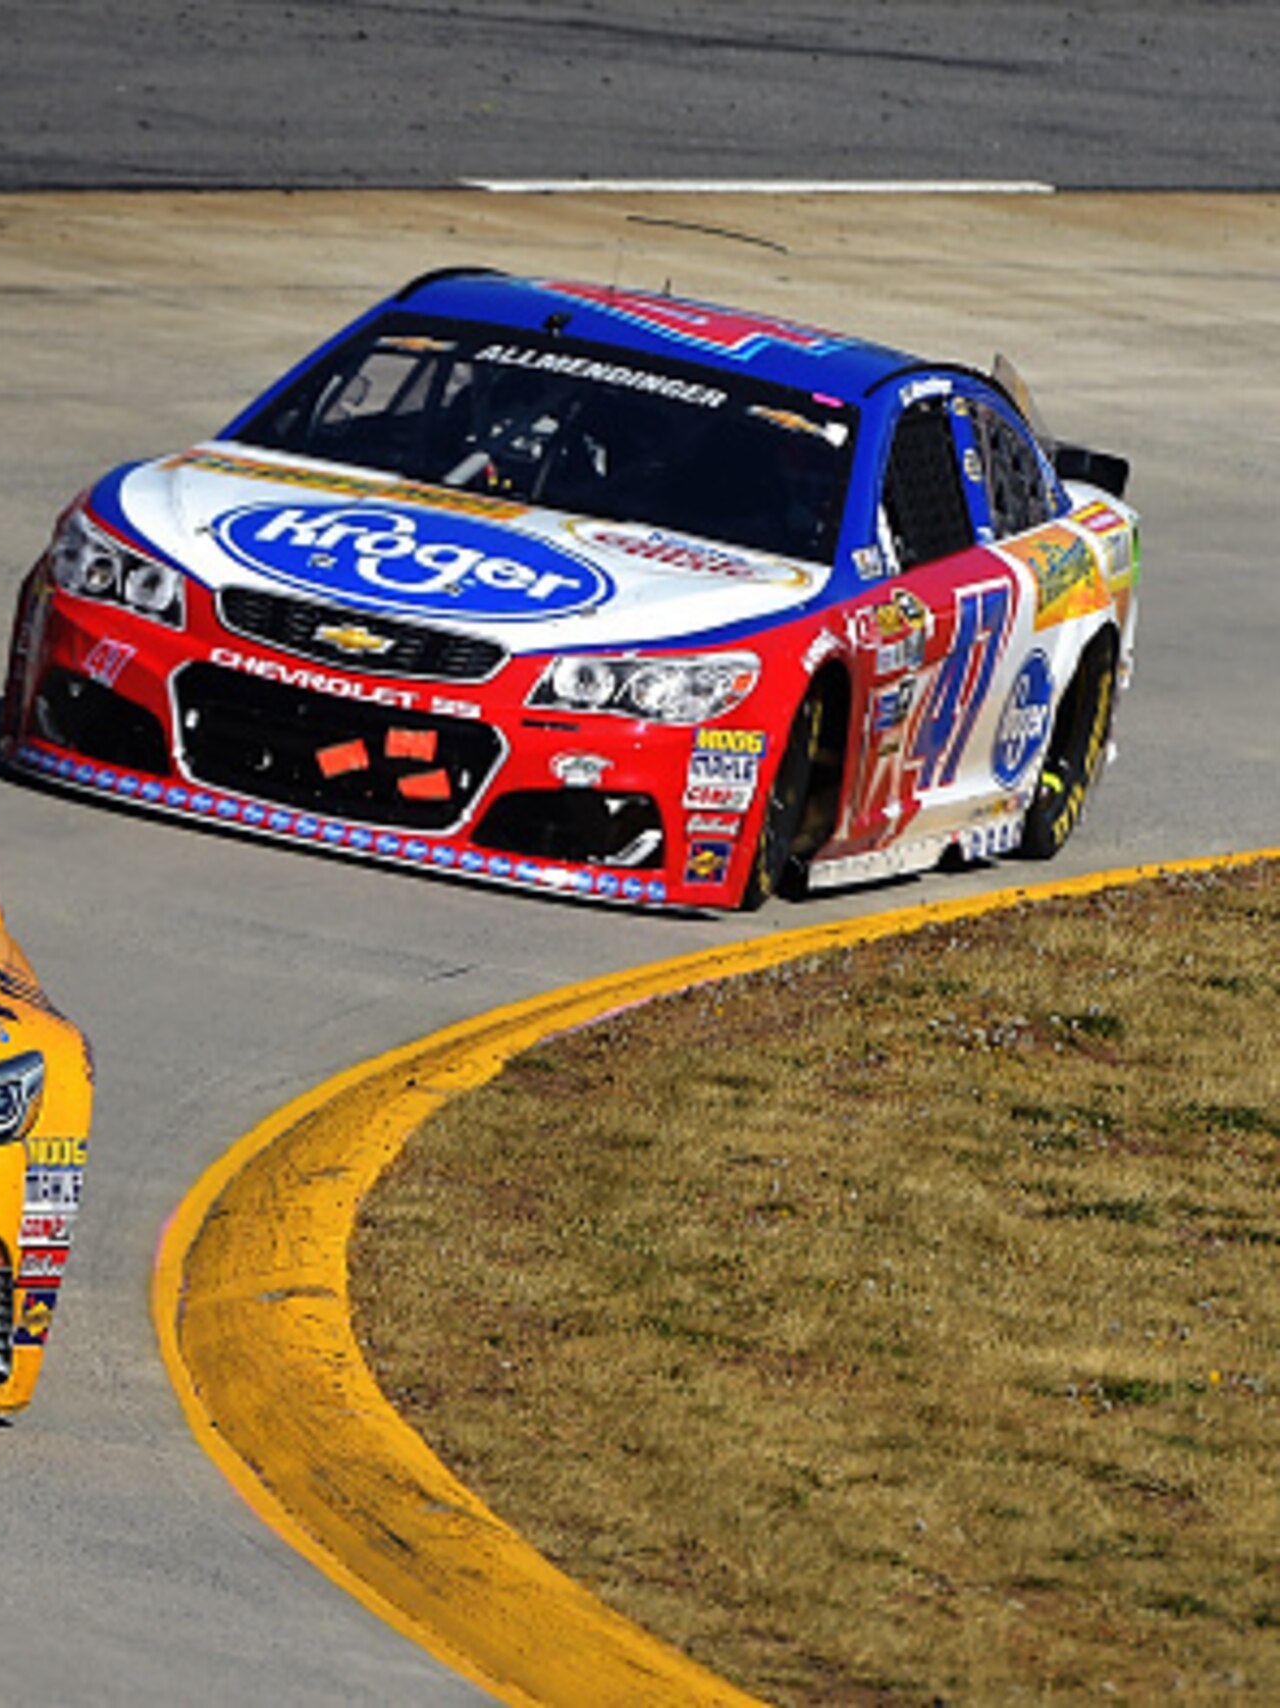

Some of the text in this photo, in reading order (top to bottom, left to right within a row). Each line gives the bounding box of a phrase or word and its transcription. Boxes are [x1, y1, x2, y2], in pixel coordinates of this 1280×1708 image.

[475, 343, 727, 408] ALLMENDINGER
[254, 506, 582, 600] Kroger
[210, 648, 420, 710] CHEVROLET
